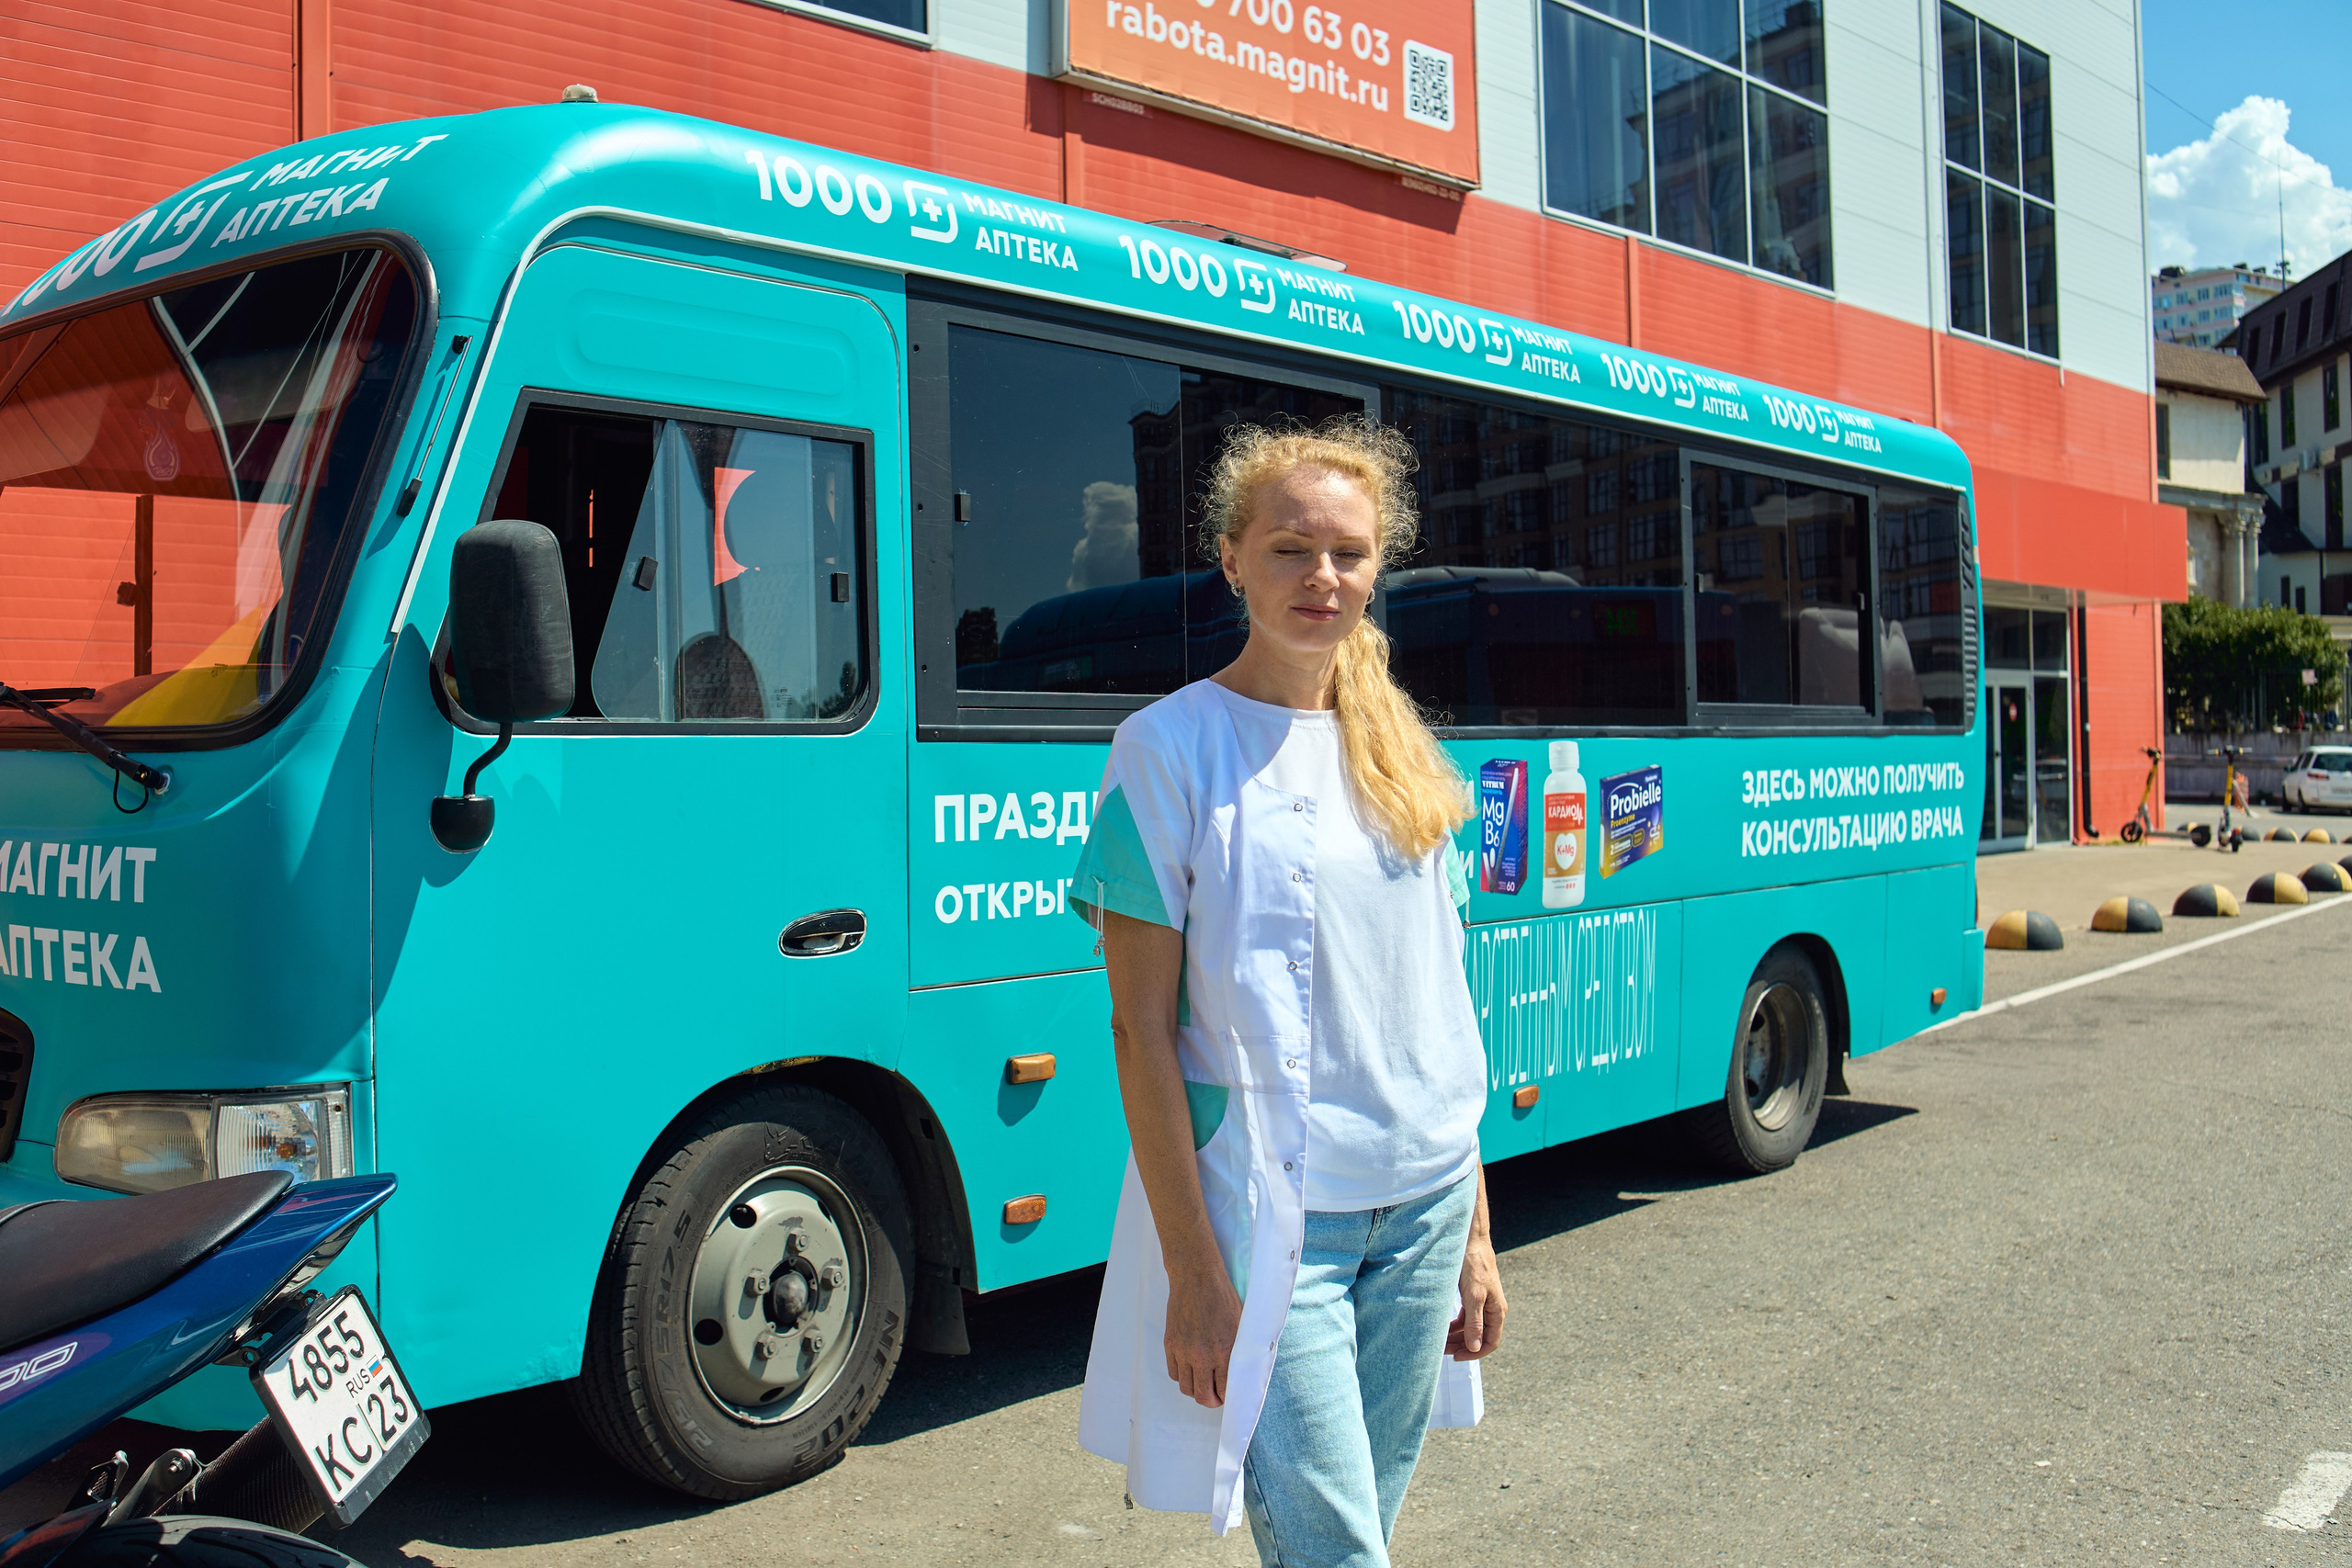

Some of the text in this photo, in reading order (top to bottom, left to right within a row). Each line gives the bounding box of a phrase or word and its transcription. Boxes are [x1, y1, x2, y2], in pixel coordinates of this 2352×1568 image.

[1106, 0, 1389, 112] rabota.magnit.ru
[1303, 6, 1342, 50] 63
[1351, 22, 1390, 66] 03
[249, 133, 449, 191] МАГНИТ
[744, 149, 892, 224] 1000
[211, 178, 389, 248] АПТЕКА
[961, 192, 1067, 233] МАГНИТ
[975, 227, 1079, 271] АПТЕКА
[1118, 234, 1227, 298] 1000
[1276, 268, 1357, 303] МАГНИТ
[1288, 299, 1365, 335] АПТЕКА
[1392, 300, 1476, 354] 1000
[1510, 325, 1573, 355] МАГНИТ
[1521, 355, 1580, 384] АПТЕКА
[1600, 352, 1667, 398] 1000
[1691, 371, 1741, 396] МАГНИТ
[1702, 395, 1748, 423] АПТЕКА
[1761, 395, 1816, 434] 1000
[1838, 409, 1875, 432] МАГНИТ
[1844, 430, 1882, 453] АПТЕКА
[1610, 782, 1662, 820] Probielle
[1742, 762, 1964, 808] ЗДЕСЬ МОЖНО ПОЛУЧИТЬ
[934, 791, 1099, 845] ПРАЗД
[1482, 795, 1505, 827] Mg
[1741, 806, 1963, 857] КОНСУЛЬТАЦИЮ ВРАЧА
[934, 878, 1074, 924] ОТКРЫ
[1574, 908, 1657, 1076] СРЕДСТВОМ
[288, 1310, 365, 1402] 4855
[345, 1368, 370, 1399] RUS
[367, 1375, 409, 1443] 23
